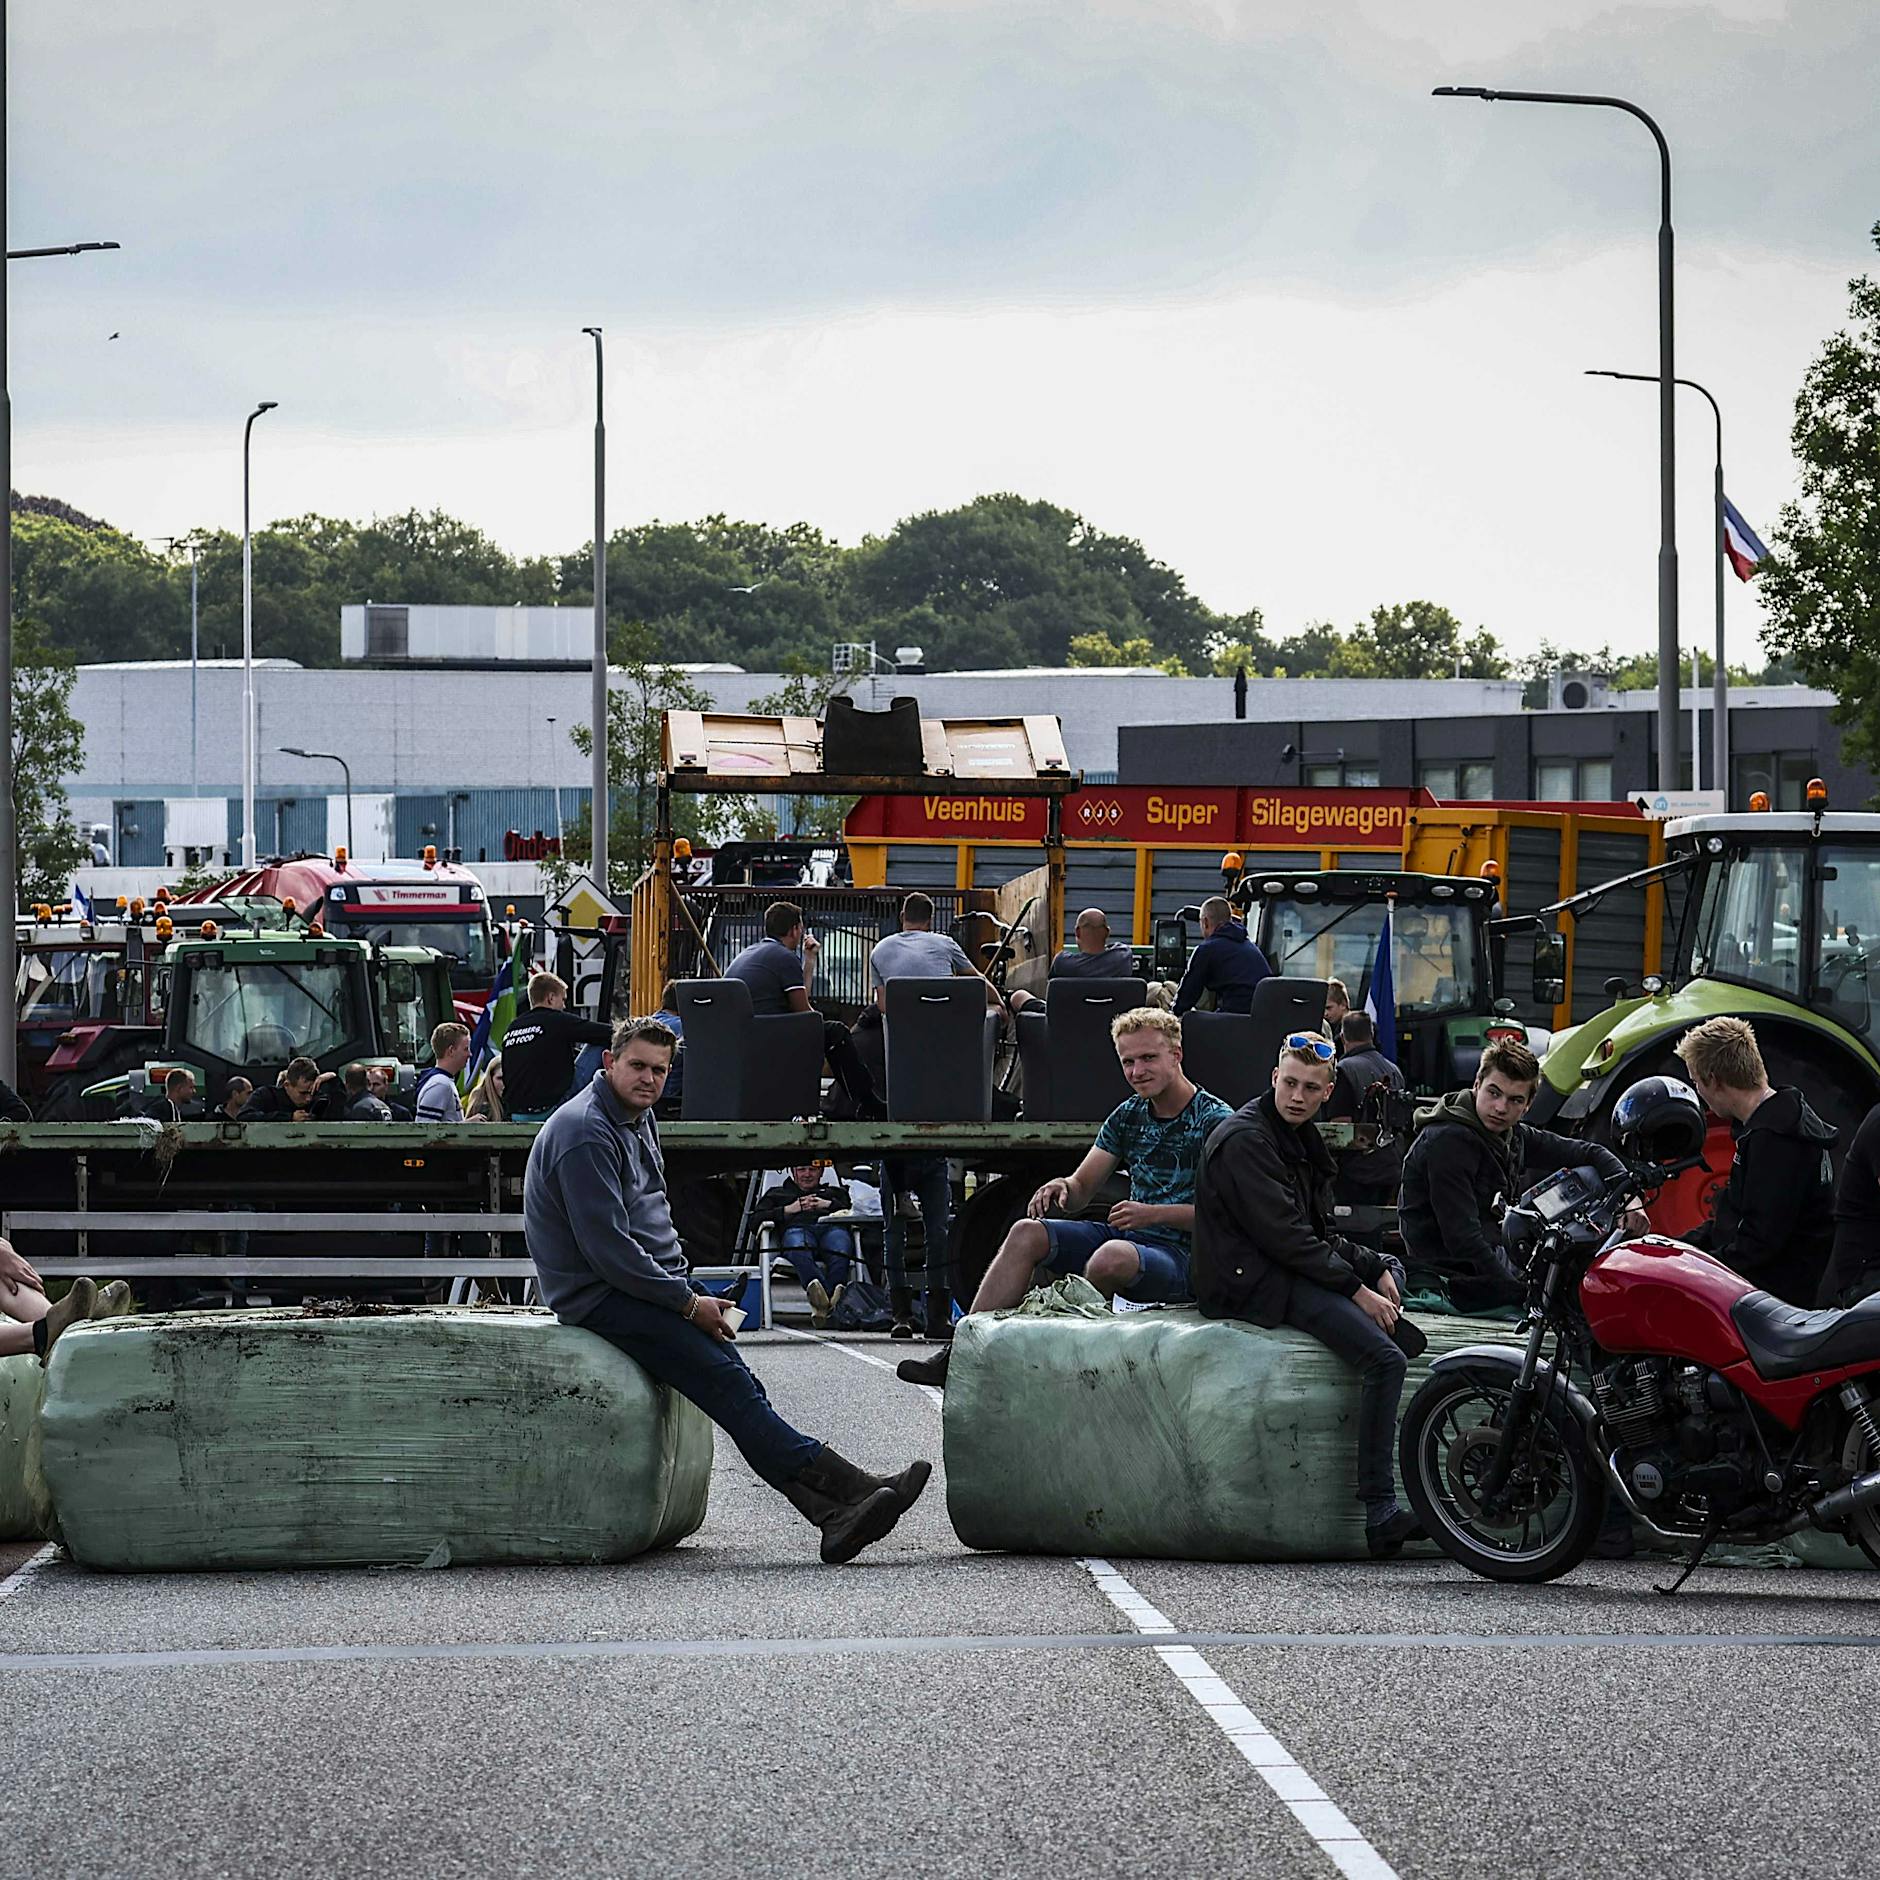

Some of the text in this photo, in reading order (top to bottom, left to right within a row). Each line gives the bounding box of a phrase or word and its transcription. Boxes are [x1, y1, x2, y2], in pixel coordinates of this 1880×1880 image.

[924, 796, 1025, 821] Veenhuis
[1147, 796, 1403, 834] Super Silagewagen
[392, 890, 447, 900] Timmerman
[515, 1034, 535, 1044] FOOD
